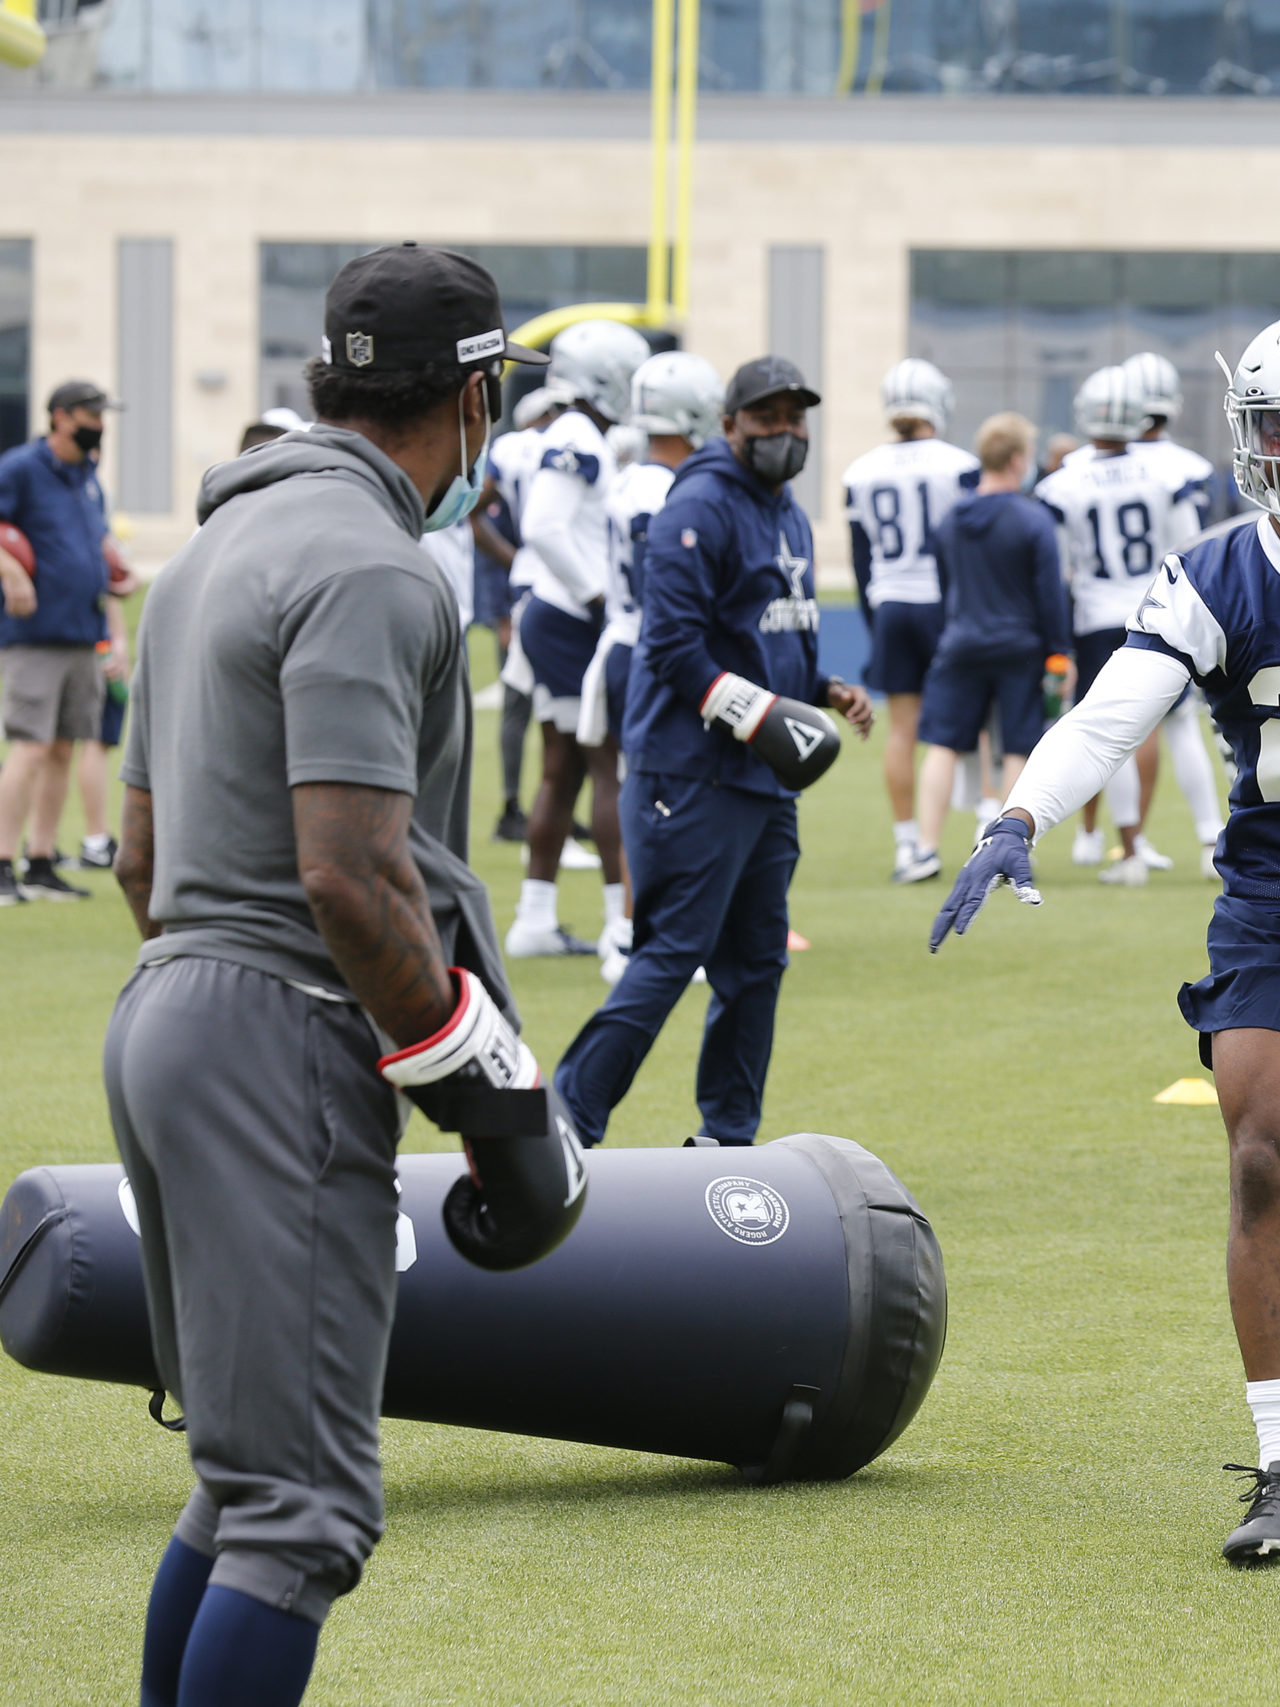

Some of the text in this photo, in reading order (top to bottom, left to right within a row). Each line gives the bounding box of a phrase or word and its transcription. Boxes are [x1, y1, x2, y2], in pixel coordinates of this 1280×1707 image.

[871, 482, 931, 559] 81
[1087, 502, 1153, 579] 18
[712, 1181, 768, 1239] ROGERS ATHLETIC COMPANY
[726, 1193, 771, 1223] R
